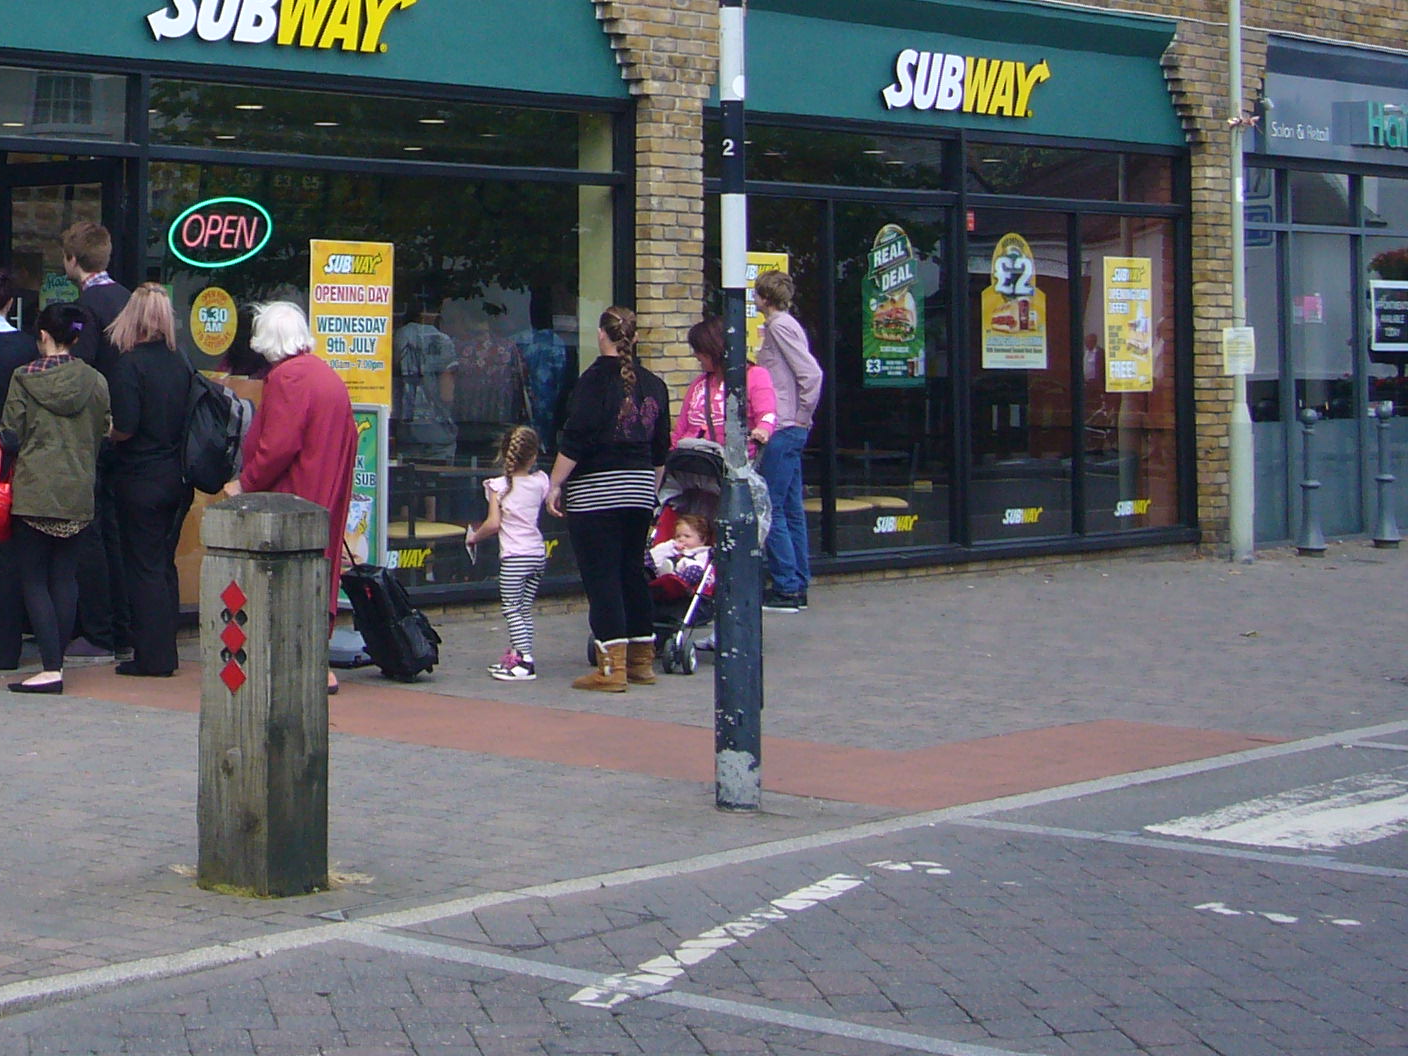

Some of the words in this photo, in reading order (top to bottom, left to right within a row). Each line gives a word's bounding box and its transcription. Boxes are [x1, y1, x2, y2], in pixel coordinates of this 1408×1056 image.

[882, 49, 1052, 118] SUBWAY
[1271, 121, 1294, 138] Salon
[1297, 124, 1304, 139] &
[722, 138, 735, 156] 2
[182, 214, 258, 249] OPEN
[874, 241, 905, 268] REAL
[324, 253, 382, 275] SUBWAY
[882, 263, 913, 292] DEAL
[994, 256, 1035, 296] £2
[1112, 266, 1145, 282] SUBWAY
[315, 285, 364, 302] OPENING
[368, 287, 389, 303] DAY
[204, 322, 224, 332] AM
[317, 316, 386, 333] WEDNESDAY
[326, 337, 346, 353] 9th
[350, 338, 376, 353] JULY
[866, 359, 881, 373] £3
[1109, 360, 1136, 378] FREE!
[355, 473, 376, 485] SUB
[1002, 507, 1043, 524] SUBWAY
[1114, 499, 1152, 517] SUBWAY
[873, 515, 919, 533] SUBWAY
[386, 548, 432, 569] BWAY
